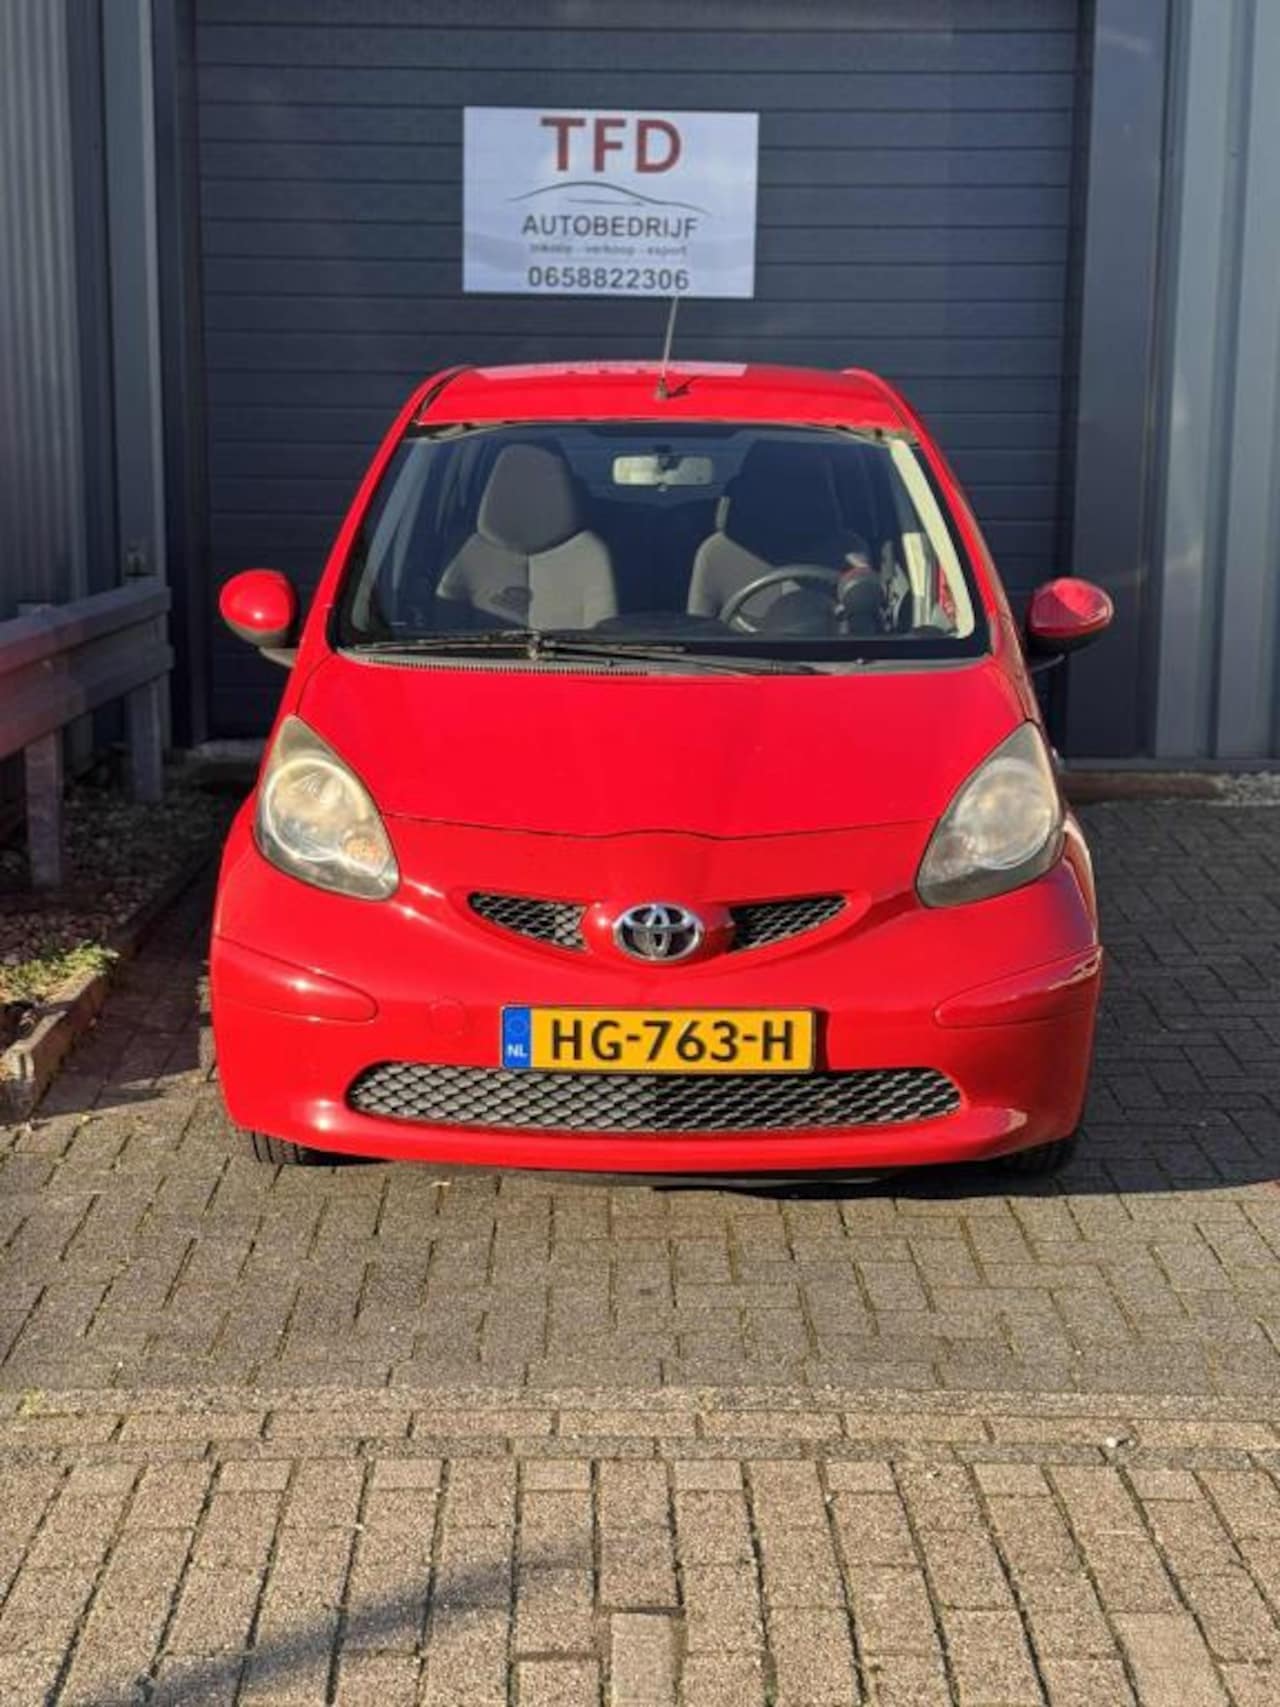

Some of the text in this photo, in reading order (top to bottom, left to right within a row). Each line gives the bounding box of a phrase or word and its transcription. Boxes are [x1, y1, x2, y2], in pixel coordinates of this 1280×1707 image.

[540, 116, 682, 174] TFD
[521, 214, 698, 239] AUTOBEDRIJF
[528, 266, 690, 290] 0658822306
[507, 1044, 527, 1057] NL
[551, 1019, 794, 1063] HG-763-H
